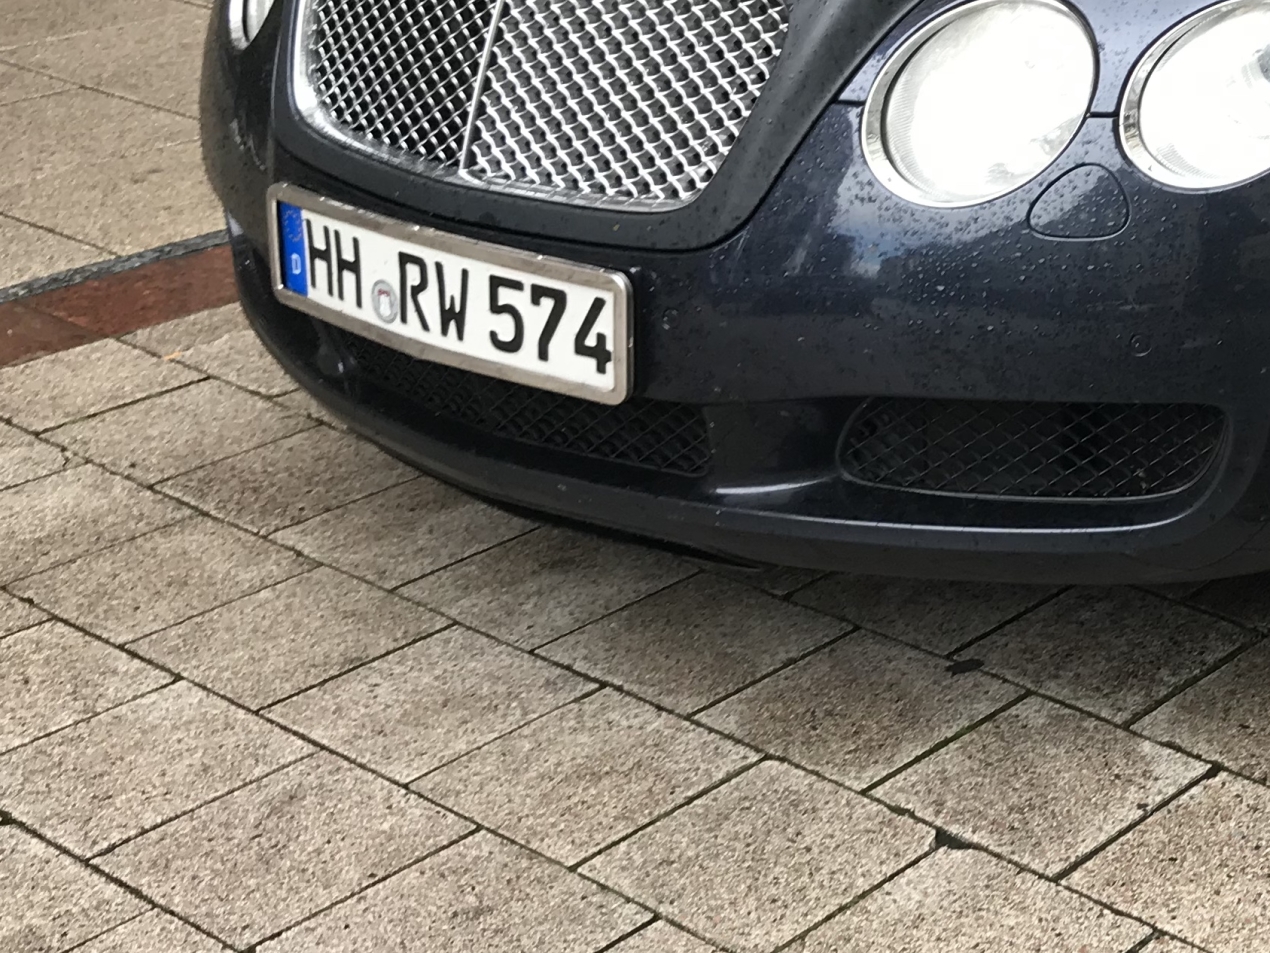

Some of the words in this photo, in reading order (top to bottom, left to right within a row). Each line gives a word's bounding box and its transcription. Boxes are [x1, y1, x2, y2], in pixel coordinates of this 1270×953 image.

[305, 218, 362, 309] HH
[398, 251, 469, 341] RW
[489, 274, 612, 374] 574
